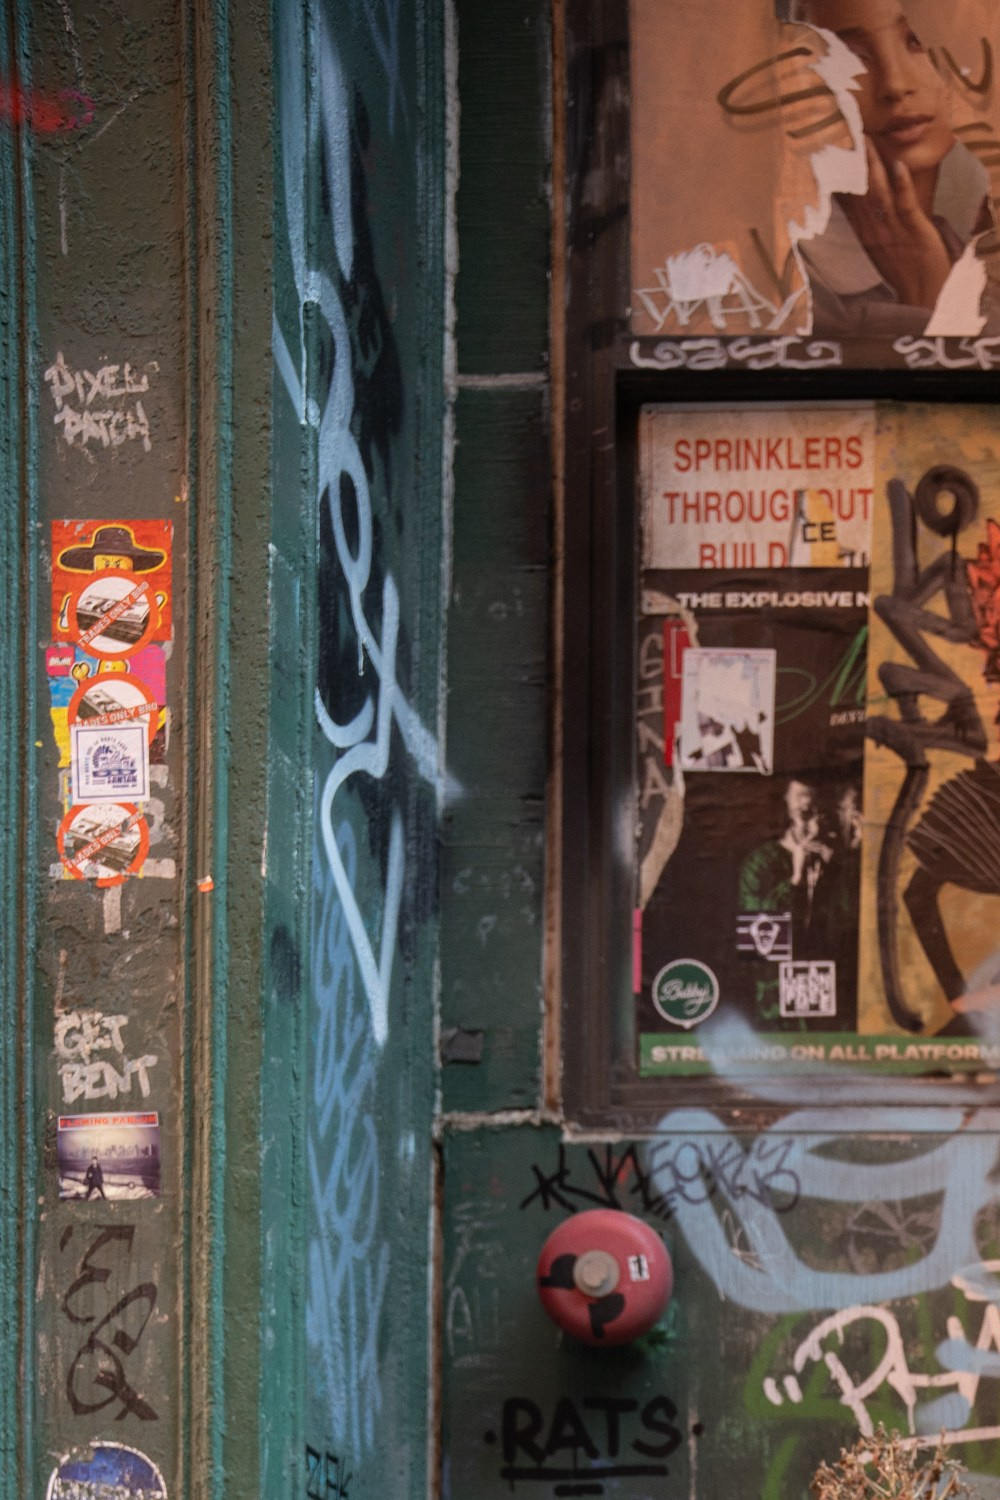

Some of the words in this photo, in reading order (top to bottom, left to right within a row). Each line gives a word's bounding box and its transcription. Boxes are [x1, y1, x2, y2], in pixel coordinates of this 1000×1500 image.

[674, 436, 863, 474] SPRINKLERS
[676, 592, 722, 608] THE
[725, 591, 850, 608] EXPLOSIVE
[659, 978, 713, 1016] Bubby's
[55, 1011, 128, 1065] GET
[791, 1045, 832, 1063] ON
[829, 1045, 872, 1063] ALL
[58, 1054, 158, 1104] BENT
[501, 1397, 684, 1463] RATS
